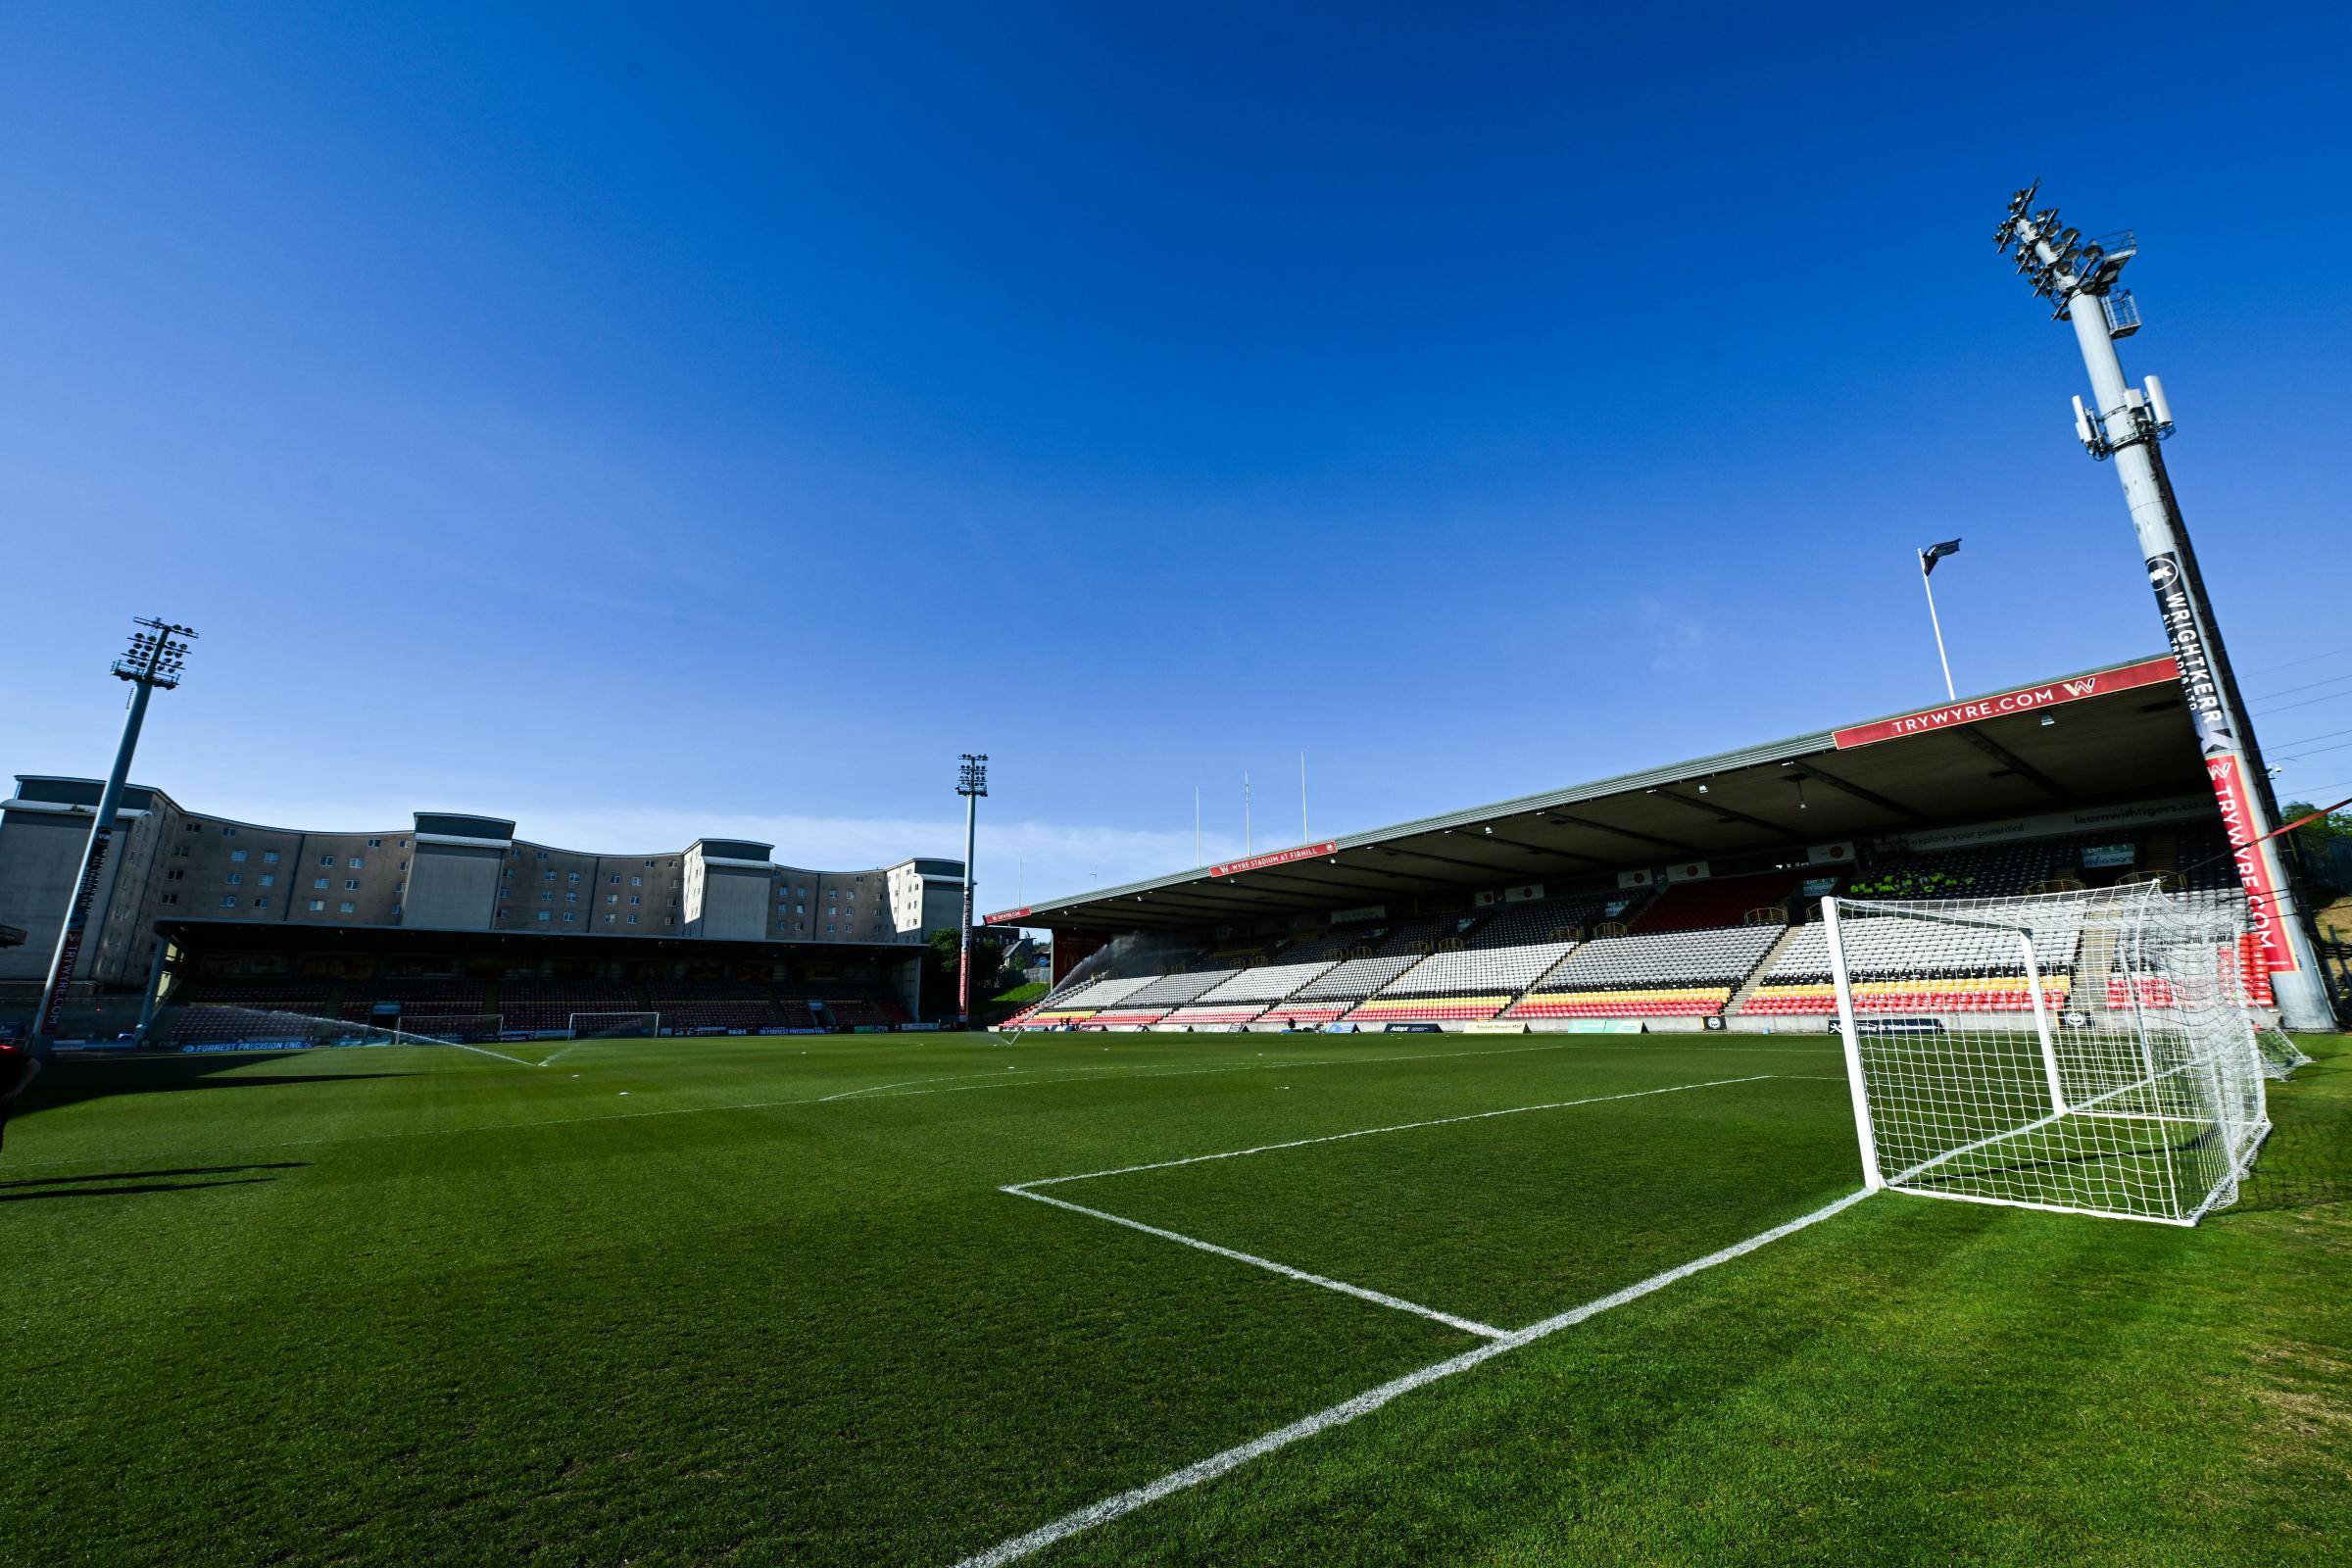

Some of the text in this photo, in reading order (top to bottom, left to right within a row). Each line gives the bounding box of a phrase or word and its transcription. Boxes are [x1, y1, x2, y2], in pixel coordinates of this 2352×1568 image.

[2162, 613, 2174, 634] ALL
[2184, 688, 2197, 711] LTD
[2166, 592, 2223, 724] WRIGHTKERR
[1892, 689, 2054, 733] TRYWYRE.COM
[1250, 856, 1279, 867] STADIUM
[1290, 848, 1318, 859] FIRHILL
[1951, 832, 1975, 844] your
[1977, 822, 2025, 837] potential
[2214, 783, 2278, 950] TRYWYRE.COM
[48, 945, 80, 1026] TRYWYRE.COM
[196, 1043, 237, 1053] FORREST
[238, 1042, 282, 1051] PRECISION
